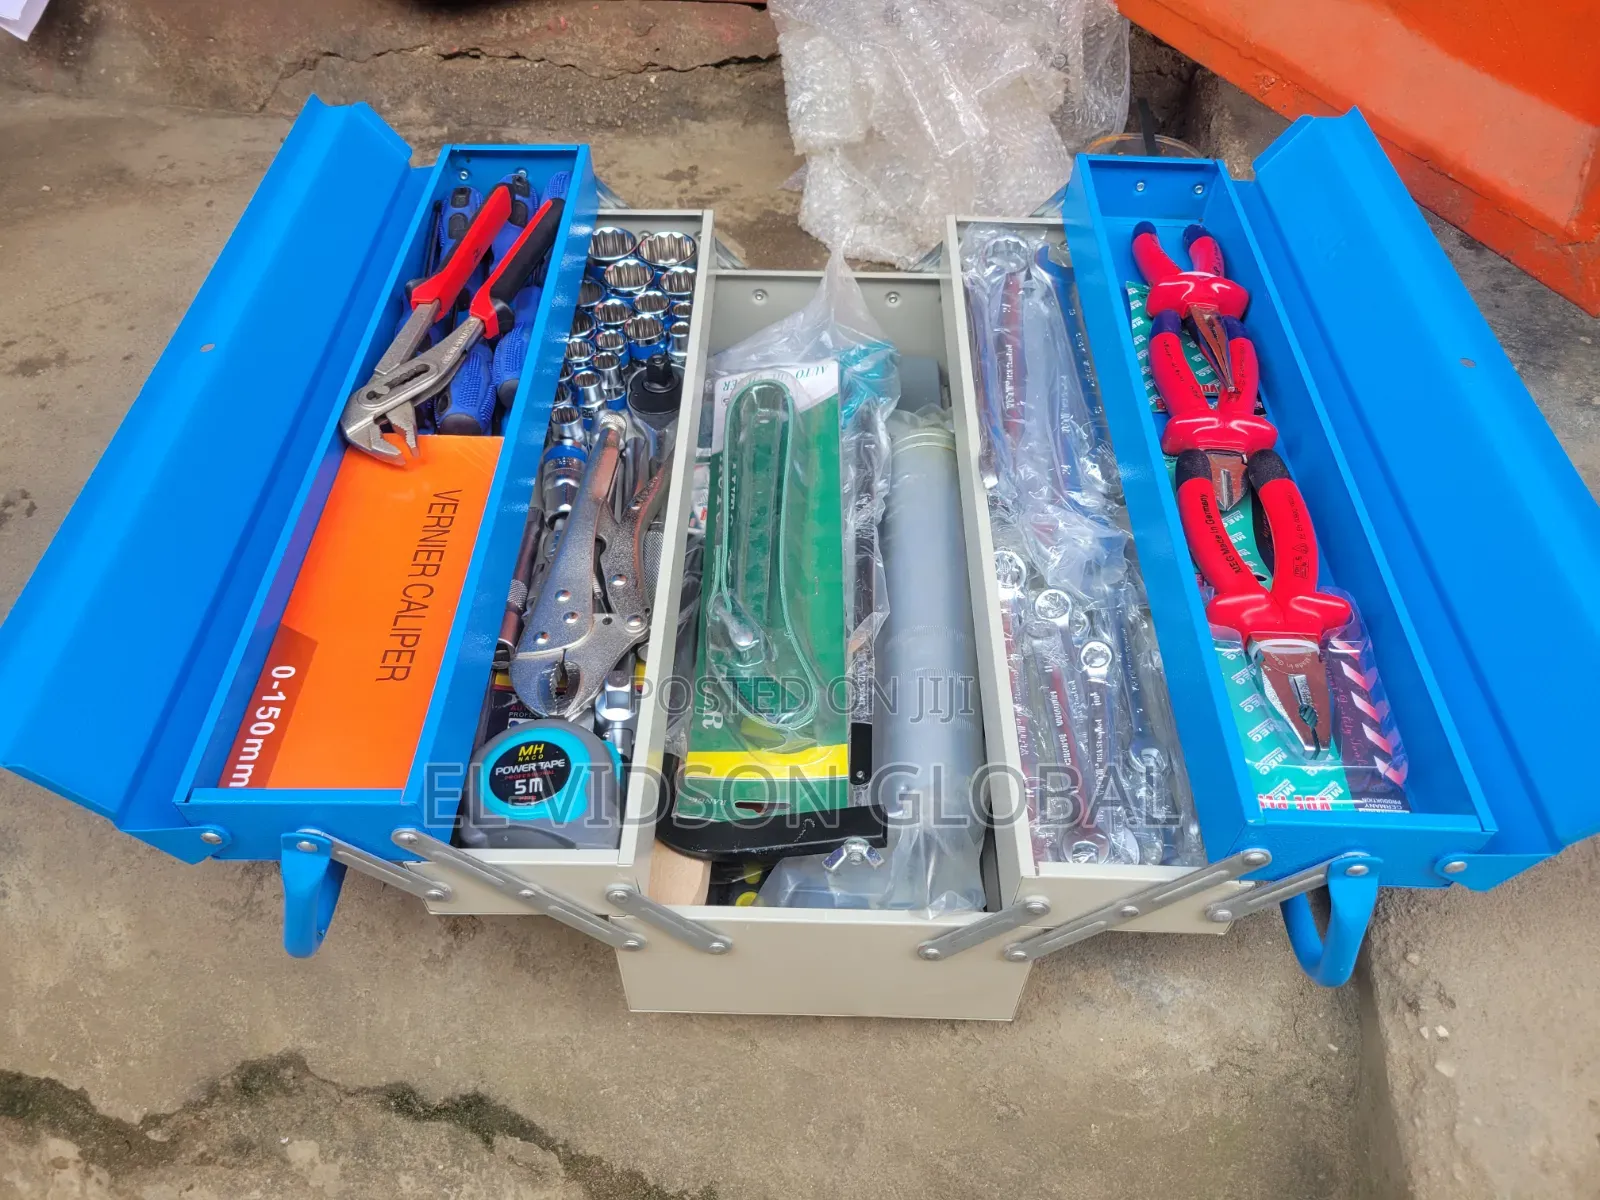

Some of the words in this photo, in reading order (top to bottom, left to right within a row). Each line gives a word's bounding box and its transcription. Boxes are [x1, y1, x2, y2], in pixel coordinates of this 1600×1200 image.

[1200, 493, 1215, 526] Germany
[406, 488, 463, 578] VERNIER
[375, 582, 435, 683] CALIPER
[229, 665, 296, 787] 0-150mm
[517, 754, 544, 762] NACO
[518, 743, 545, 757] MH
[495, 762, 537, 776] POWER
[538, 758, 566, 770] TAPE
